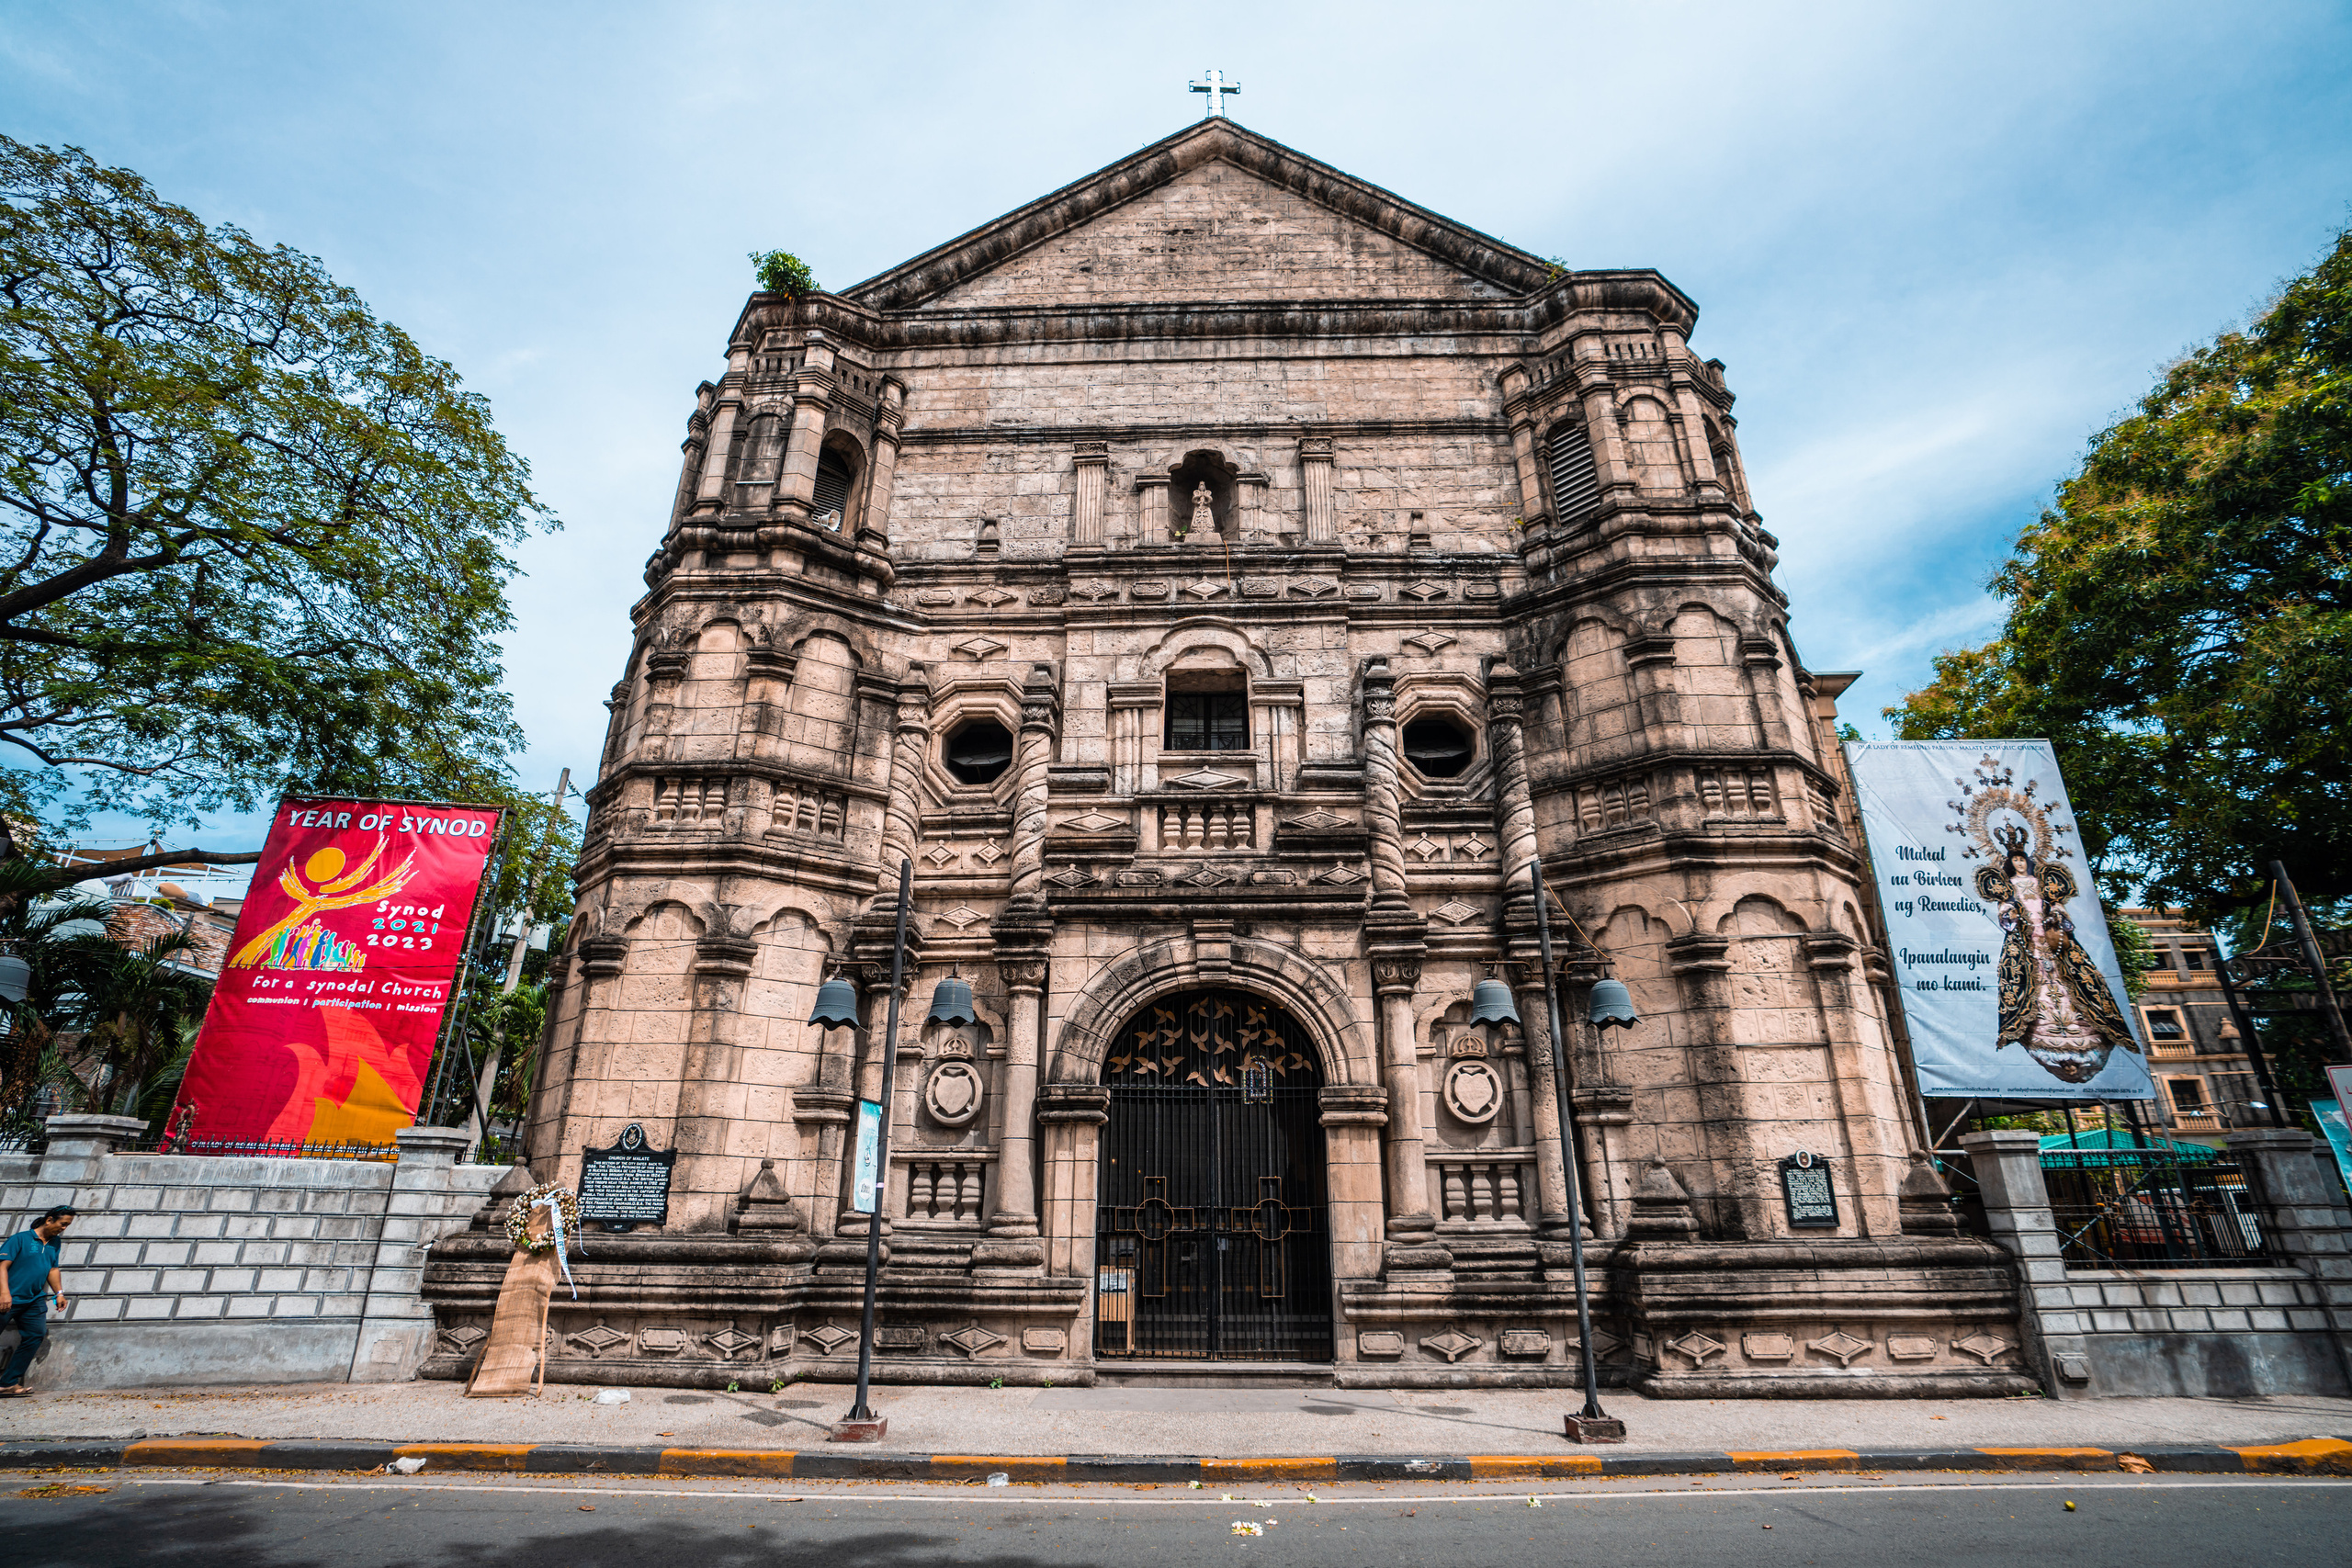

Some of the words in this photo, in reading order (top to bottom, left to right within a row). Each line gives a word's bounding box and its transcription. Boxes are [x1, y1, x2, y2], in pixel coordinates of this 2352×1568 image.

[289, 809, 351, 829] YEAR
[358, 813, 394, 832] OF
[398, 815, 486, 838] SYNOD
[1894, 845, 1946, 862] Mahal
[1891, 874, 1909, 886] na
[1913, 871, 1963, 887] Birhen
[376, 899, 444, 920] Synod
[1894, 900, 1914, 916] ng
[1917, 896, 1987, 916] Remedios,
[372, 918, 439, 935] 2021
[367, 933, 433, 951] 2023
[1899, 947, 1991, 970] Ipanalangin
[252, 975, 279, 989] For
[285, 980, 294, 989] a
[306, 977, 374, 995] synodal
[381, 982, 442, 999] Church
[1917, 979, 1939, 991] mo
[1944, 976, 1987, 991] kami.
[247, 996, 300, 1006] communion
[312, 998, 382, 1010] participation
[397, 1002, 437, 1014] mission
